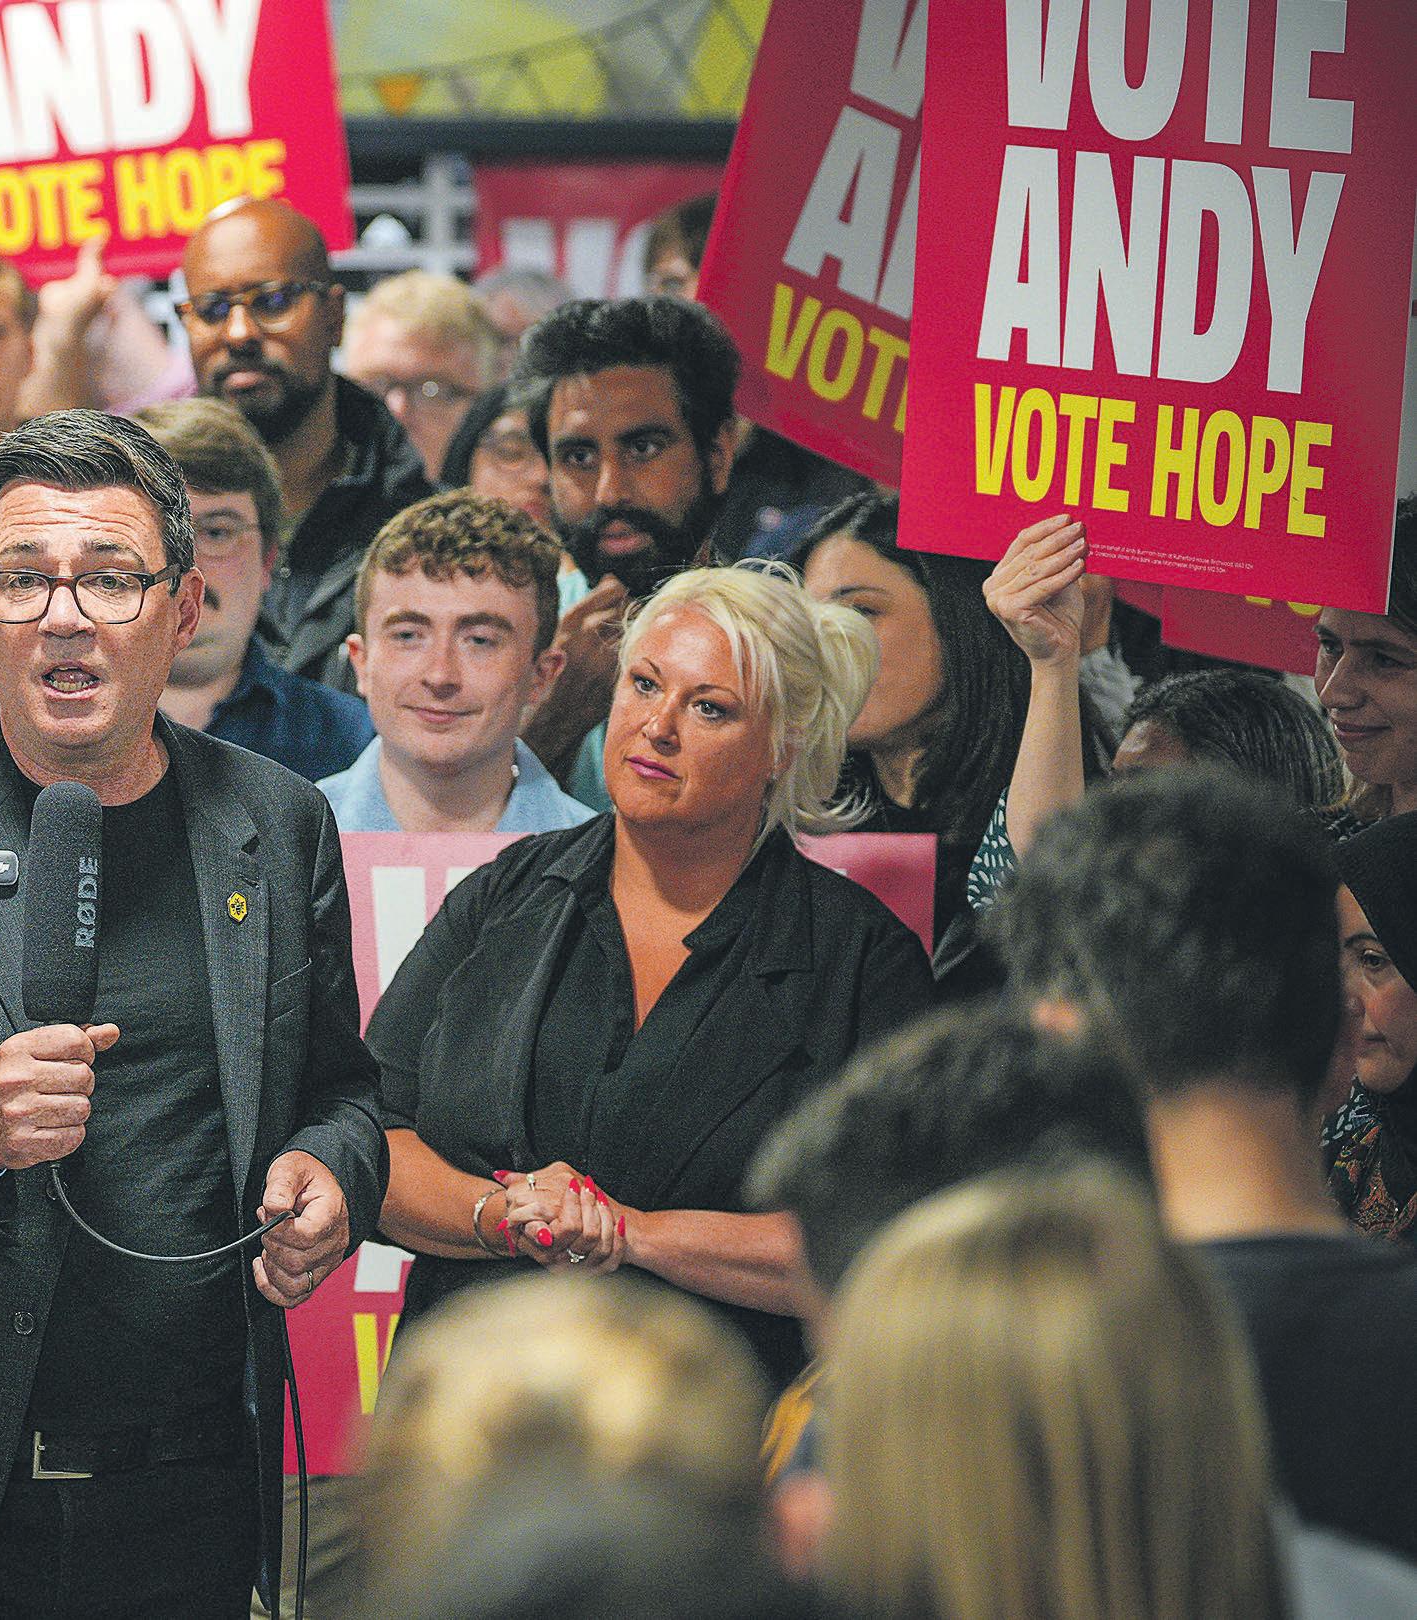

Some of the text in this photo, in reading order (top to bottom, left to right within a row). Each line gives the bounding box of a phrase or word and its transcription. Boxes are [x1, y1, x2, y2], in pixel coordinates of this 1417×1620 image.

[976, 144, 1346, 394] ANDY
[764, 282, 910, 433] VOT
[974, 383, 1333, 538] VOTE HOPE
[75, 856, 98, 948] RØDE
